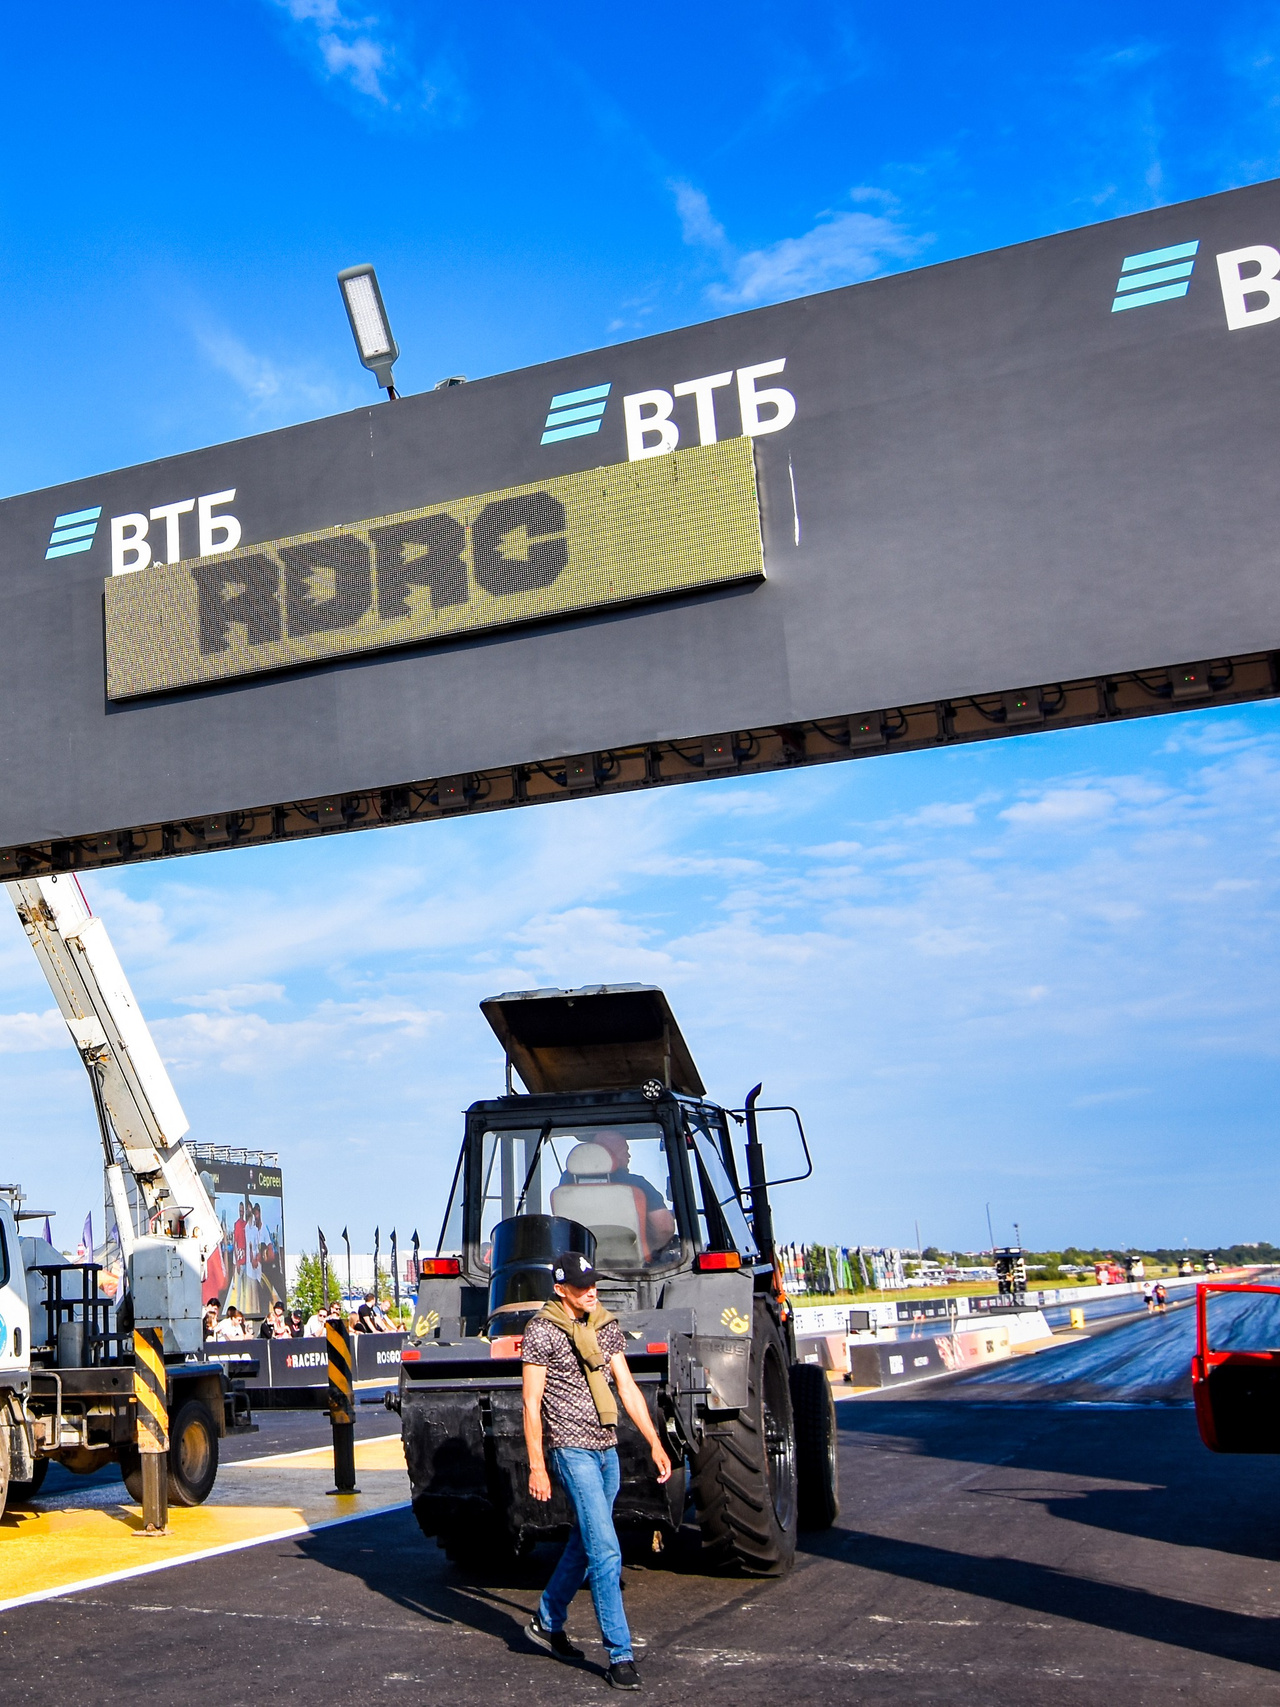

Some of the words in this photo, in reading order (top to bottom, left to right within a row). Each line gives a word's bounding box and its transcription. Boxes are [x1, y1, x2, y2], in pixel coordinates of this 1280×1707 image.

[624, 357, 797, 462] ВТБ
[110, 488, 242, 577] ВТБ
[190, 490, 570, 656] RDRC
[376, 1350, 402, 1365] ROSGO
